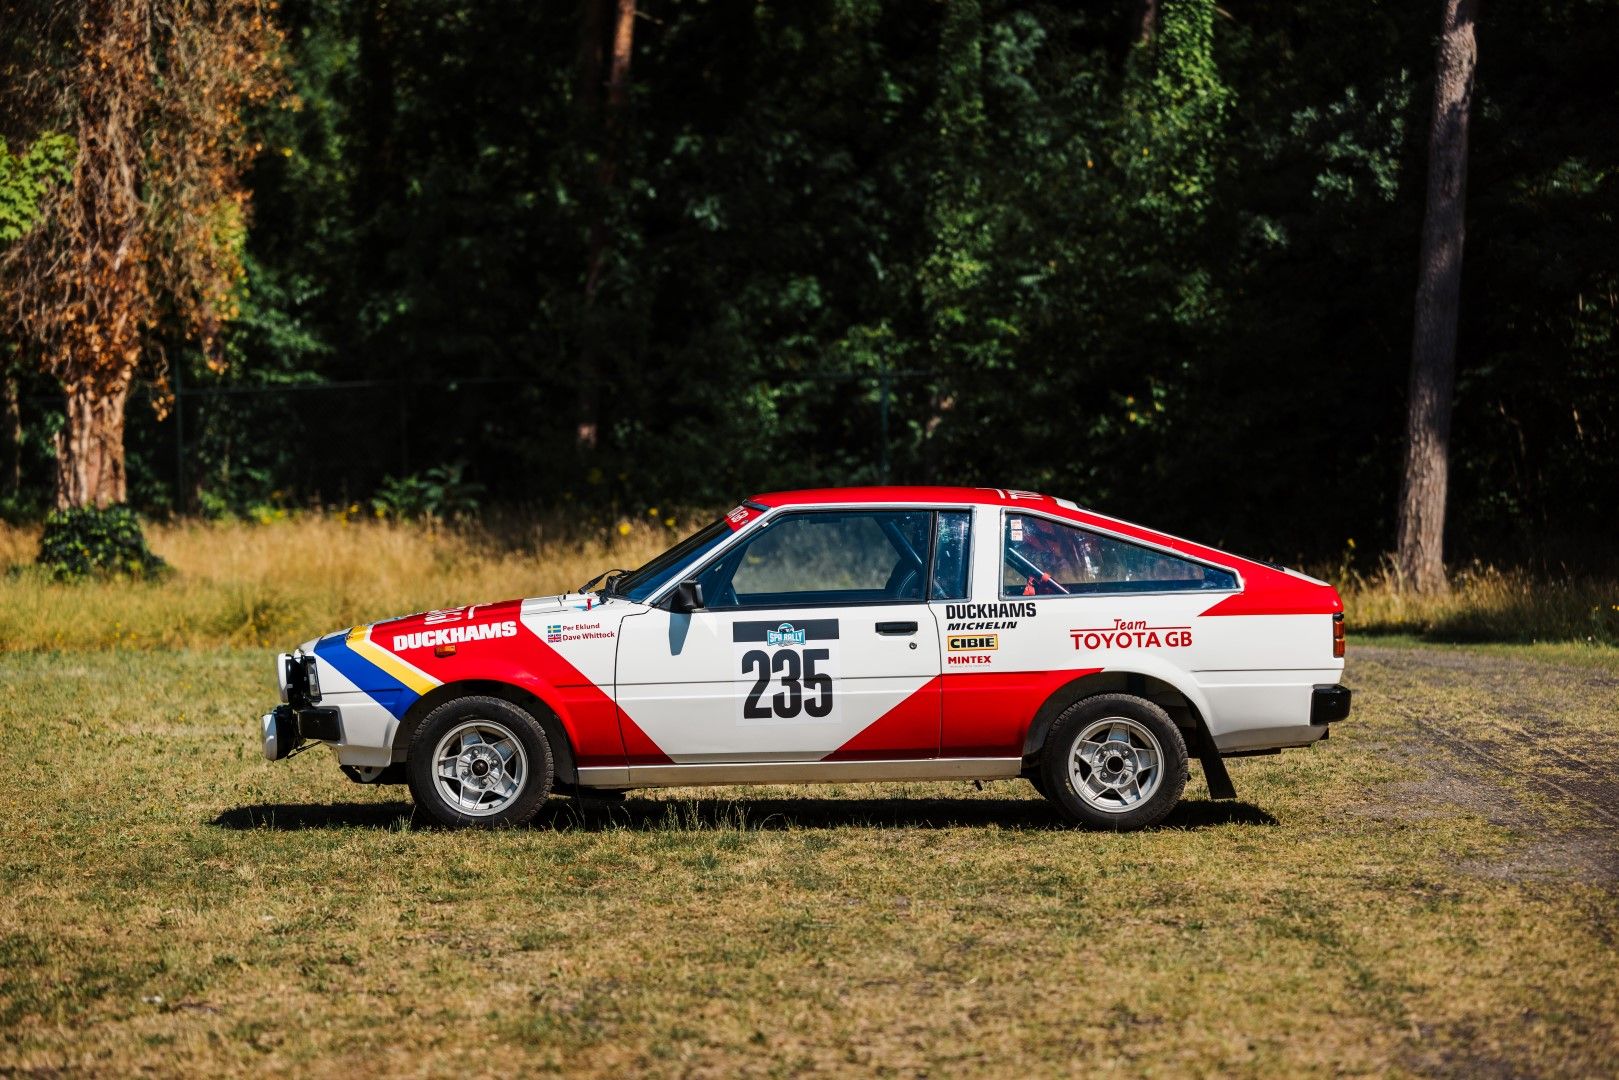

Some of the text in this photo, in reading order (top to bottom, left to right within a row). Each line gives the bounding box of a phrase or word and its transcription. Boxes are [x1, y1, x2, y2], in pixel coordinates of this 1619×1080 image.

[945, 602, 1037, 619] DUCKHAMS
[575, 622, 600, 631] Eklund
[947, 621, 1018, 631] MICHELIN
[1113, 618, 1147, 630] Team
[393, 621, 517, 651] DUCKHAMS
[582, 631, 616, 640] Whittock
[769, 632, 803, 642] SPA RALLY
[1070, 631, 1193, 650] TOYOTA GB
[947, 655, 992, 664] MINTEX
[741, 649, 833, 719] 235
